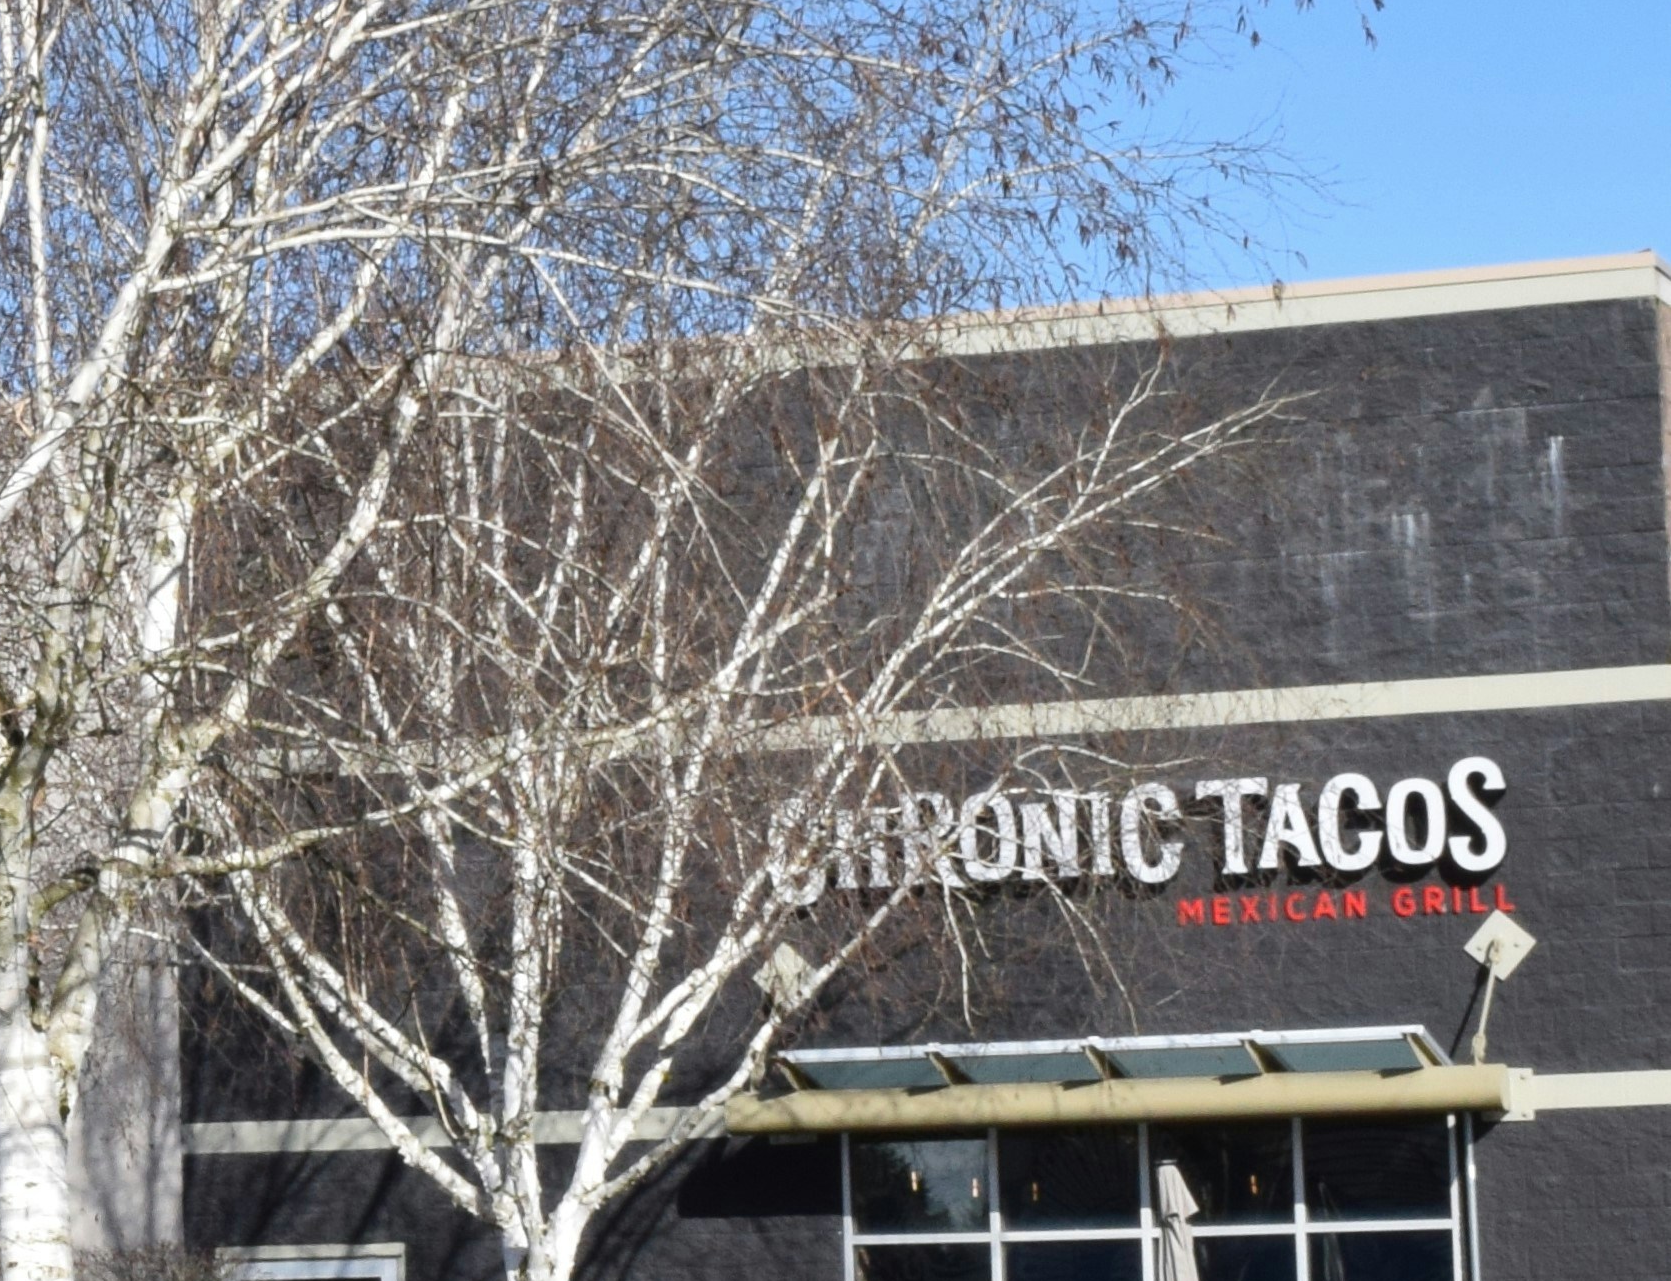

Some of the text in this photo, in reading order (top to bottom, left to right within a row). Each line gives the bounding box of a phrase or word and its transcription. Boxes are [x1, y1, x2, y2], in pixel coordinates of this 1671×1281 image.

[768, 756, 1507, 905] CHRONIC TACOS
[1176, 883, 1517, 927] MEXICAN GRILL
